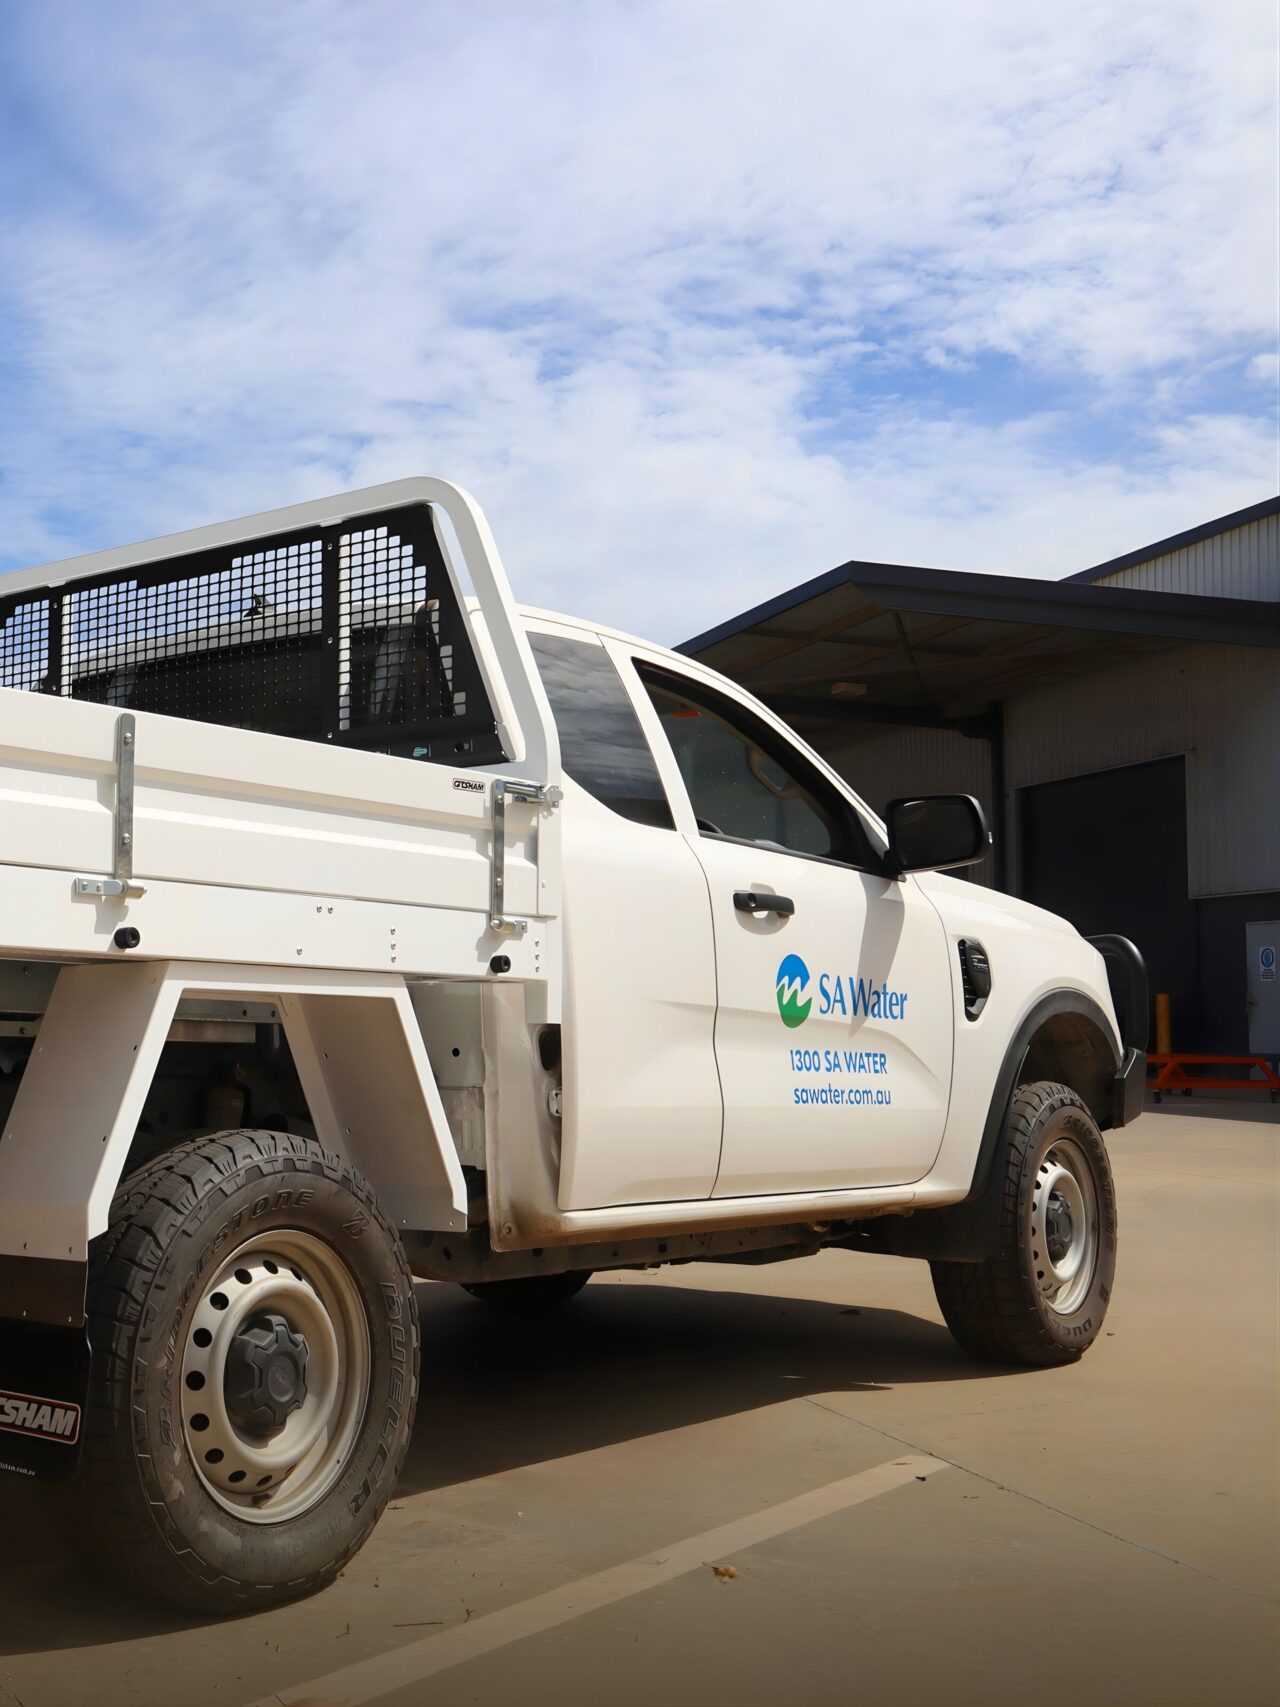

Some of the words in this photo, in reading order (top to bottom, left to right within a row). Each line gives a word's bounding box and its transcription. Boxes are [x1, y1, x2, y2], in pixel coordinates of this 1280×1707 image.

[819, 973, 847, 1015] SA
[848, 976, 908, 1020] Water
[790, 1049, 821, 1073] 1300
[824, 1050, 842, 1073] SA
[844, 1051, 888, 1074] WATER
[793, 1082, 892, 1105] sawater.com.au
[158, 1188, 316, 1447] BRIDGESTONE
